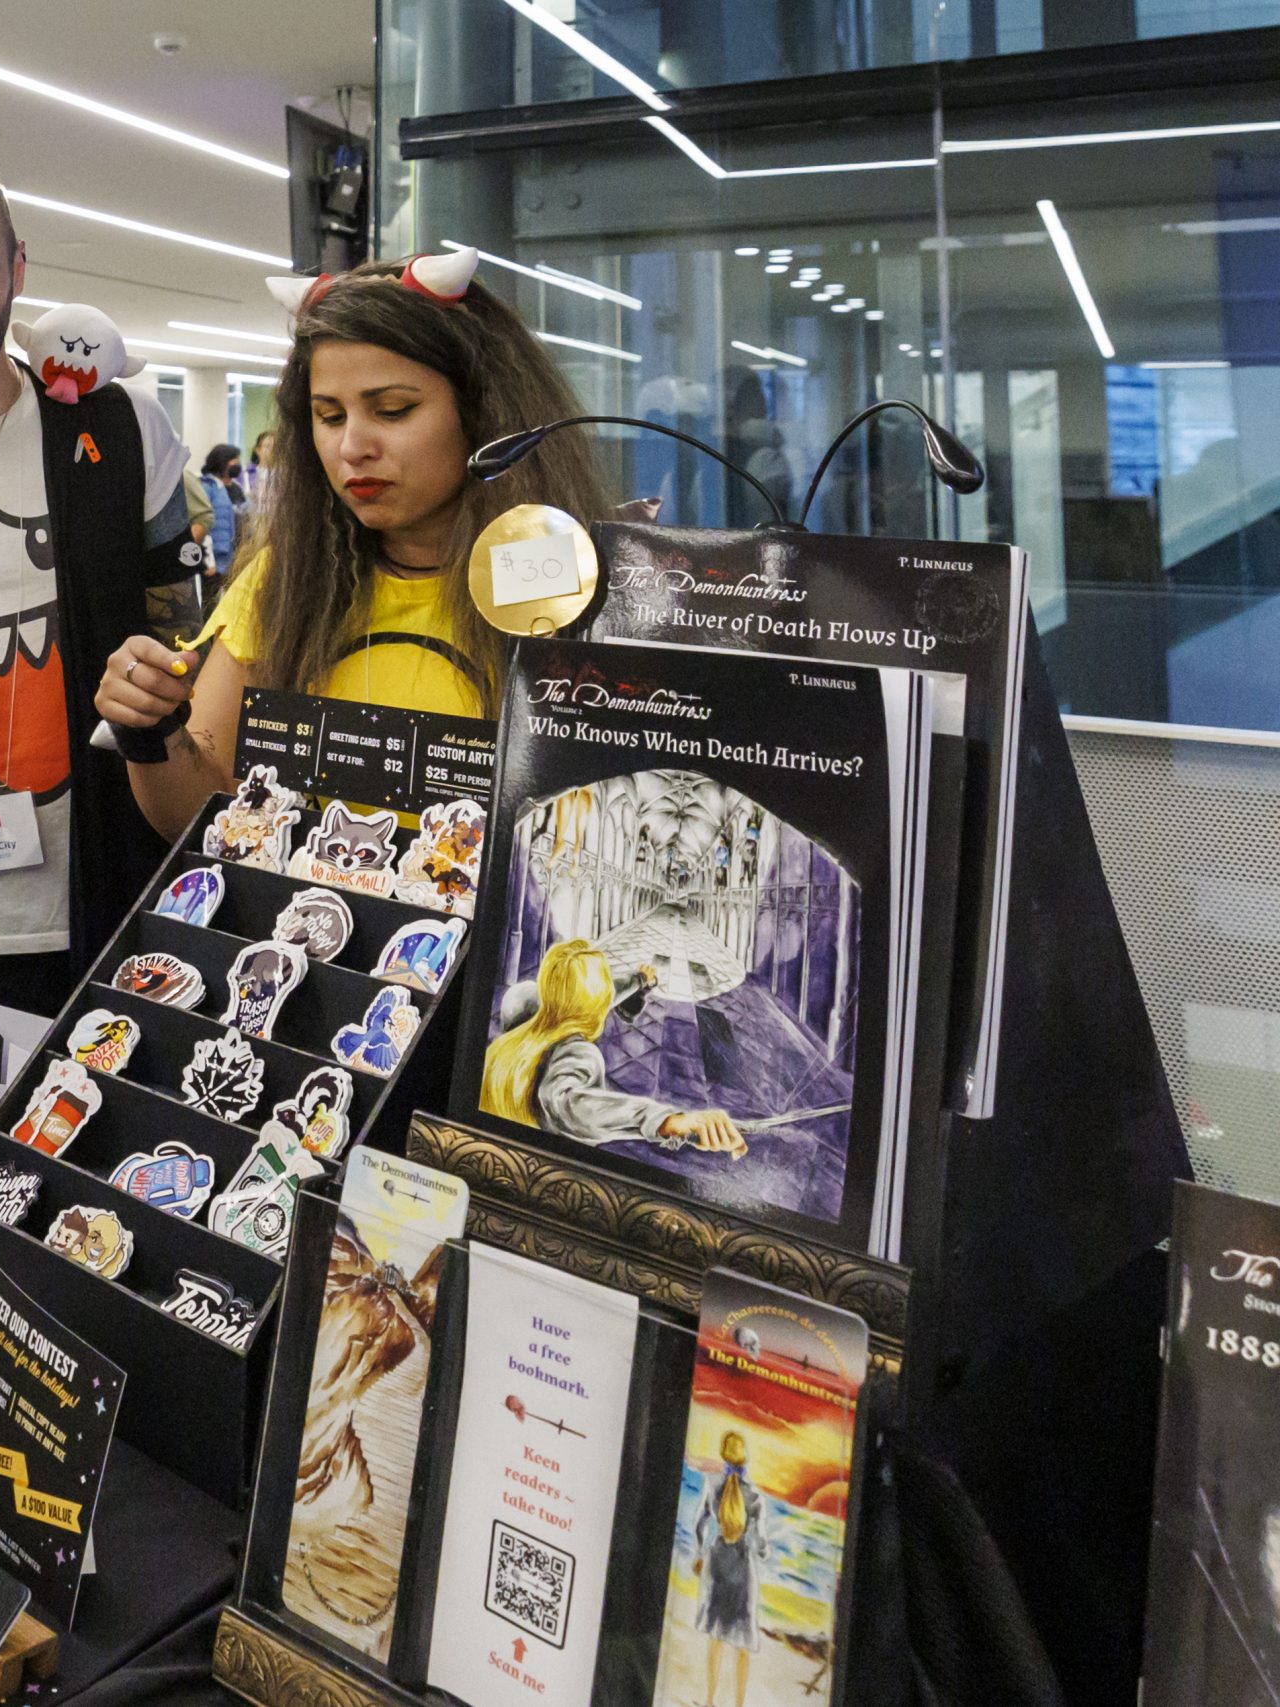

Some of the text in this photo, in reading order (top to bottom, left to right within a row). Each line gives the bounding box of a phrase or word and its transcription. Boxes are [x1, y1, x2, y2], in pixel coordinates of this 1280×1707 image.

[898, 556, 911, 568] P.
[607, 565, 807, 602] The Demonhuntress
[633, 603, 937, 655] The River of Death Flows Up
[789, 673, 801, 685] P.
[528, 679, 712, 721] The Demonhuntress
[247, 717, 258, 727] BIG
[258, 719, 289, 733] STICKERS
[296, 723, 310, 736] $3
[329, 731, 360, 744] GREETING
[360, 736, 381, 748] CARDS
[386, 737, 401, 751] $5
[442, 733, 456, 744] Ask
[467, 738, 490, 749] about
[245, 738, 262, 748] SMALL
[262, 740, 287, 753] STICKERS
[293, 742, 307, 756] $2
[326, 752, 338, 762] SET
[338, 754, 346, 763] OF
[346, 755, 352, 764] 3
[427, 744, 466, 762] CUSTOM
[527, 716, 864, 778] Who Knows When Death Arrives?
[384, 758, 403, 773] $12
[425, 764, 448, 781] $25
[453, 773, 467, 784] PER
[310, 863, 386, 893] NO JUNK MAIL!
[137, 955, 164, 971] STAY
[240, 996, 273, 1018] TRASHY
[83, 1040, 115, 1069] BUZZ
[101, 1041, 127, 1072] OFF!
[175, 1160, 191, 1196] HYDRATE
[361, 1154, 458, 1197] The Demonhuntress
[1210, 1249, 1280, 1287] The
[531, 1316, 571, 1341] Have
[8, 1311, 30, 1343] OUR
[27, 1328, 79, 1382] CONTEST
[528, 1341, 572, 1366] a free
[1206, 1326, 1280, 1368] 1888
[2, 1339, 18, 1359] idea
[14, 1349, 29, 1368] for
[27, 1360, 42, 1379] the
[40, 1370, 80, 1409] holidays!
[508, 1355, 590, 1399] bookmark.
[708, 1346, 857, 1409] The Demonhuntress
[17, 1396, 67, 1445] DIGITAL COPY READY
[14, 1410, 67, 1463] TO PRINT AT ANY SIZE
[523, 1445, 561, 1474] Keen
[504, 1465, 561, 1500] readers
[22, 1495, 73, 1525] A $100 VALUE
[502, 1491, 573, 1533] take two!
[488, 1650, 546, 1694] Scan me
